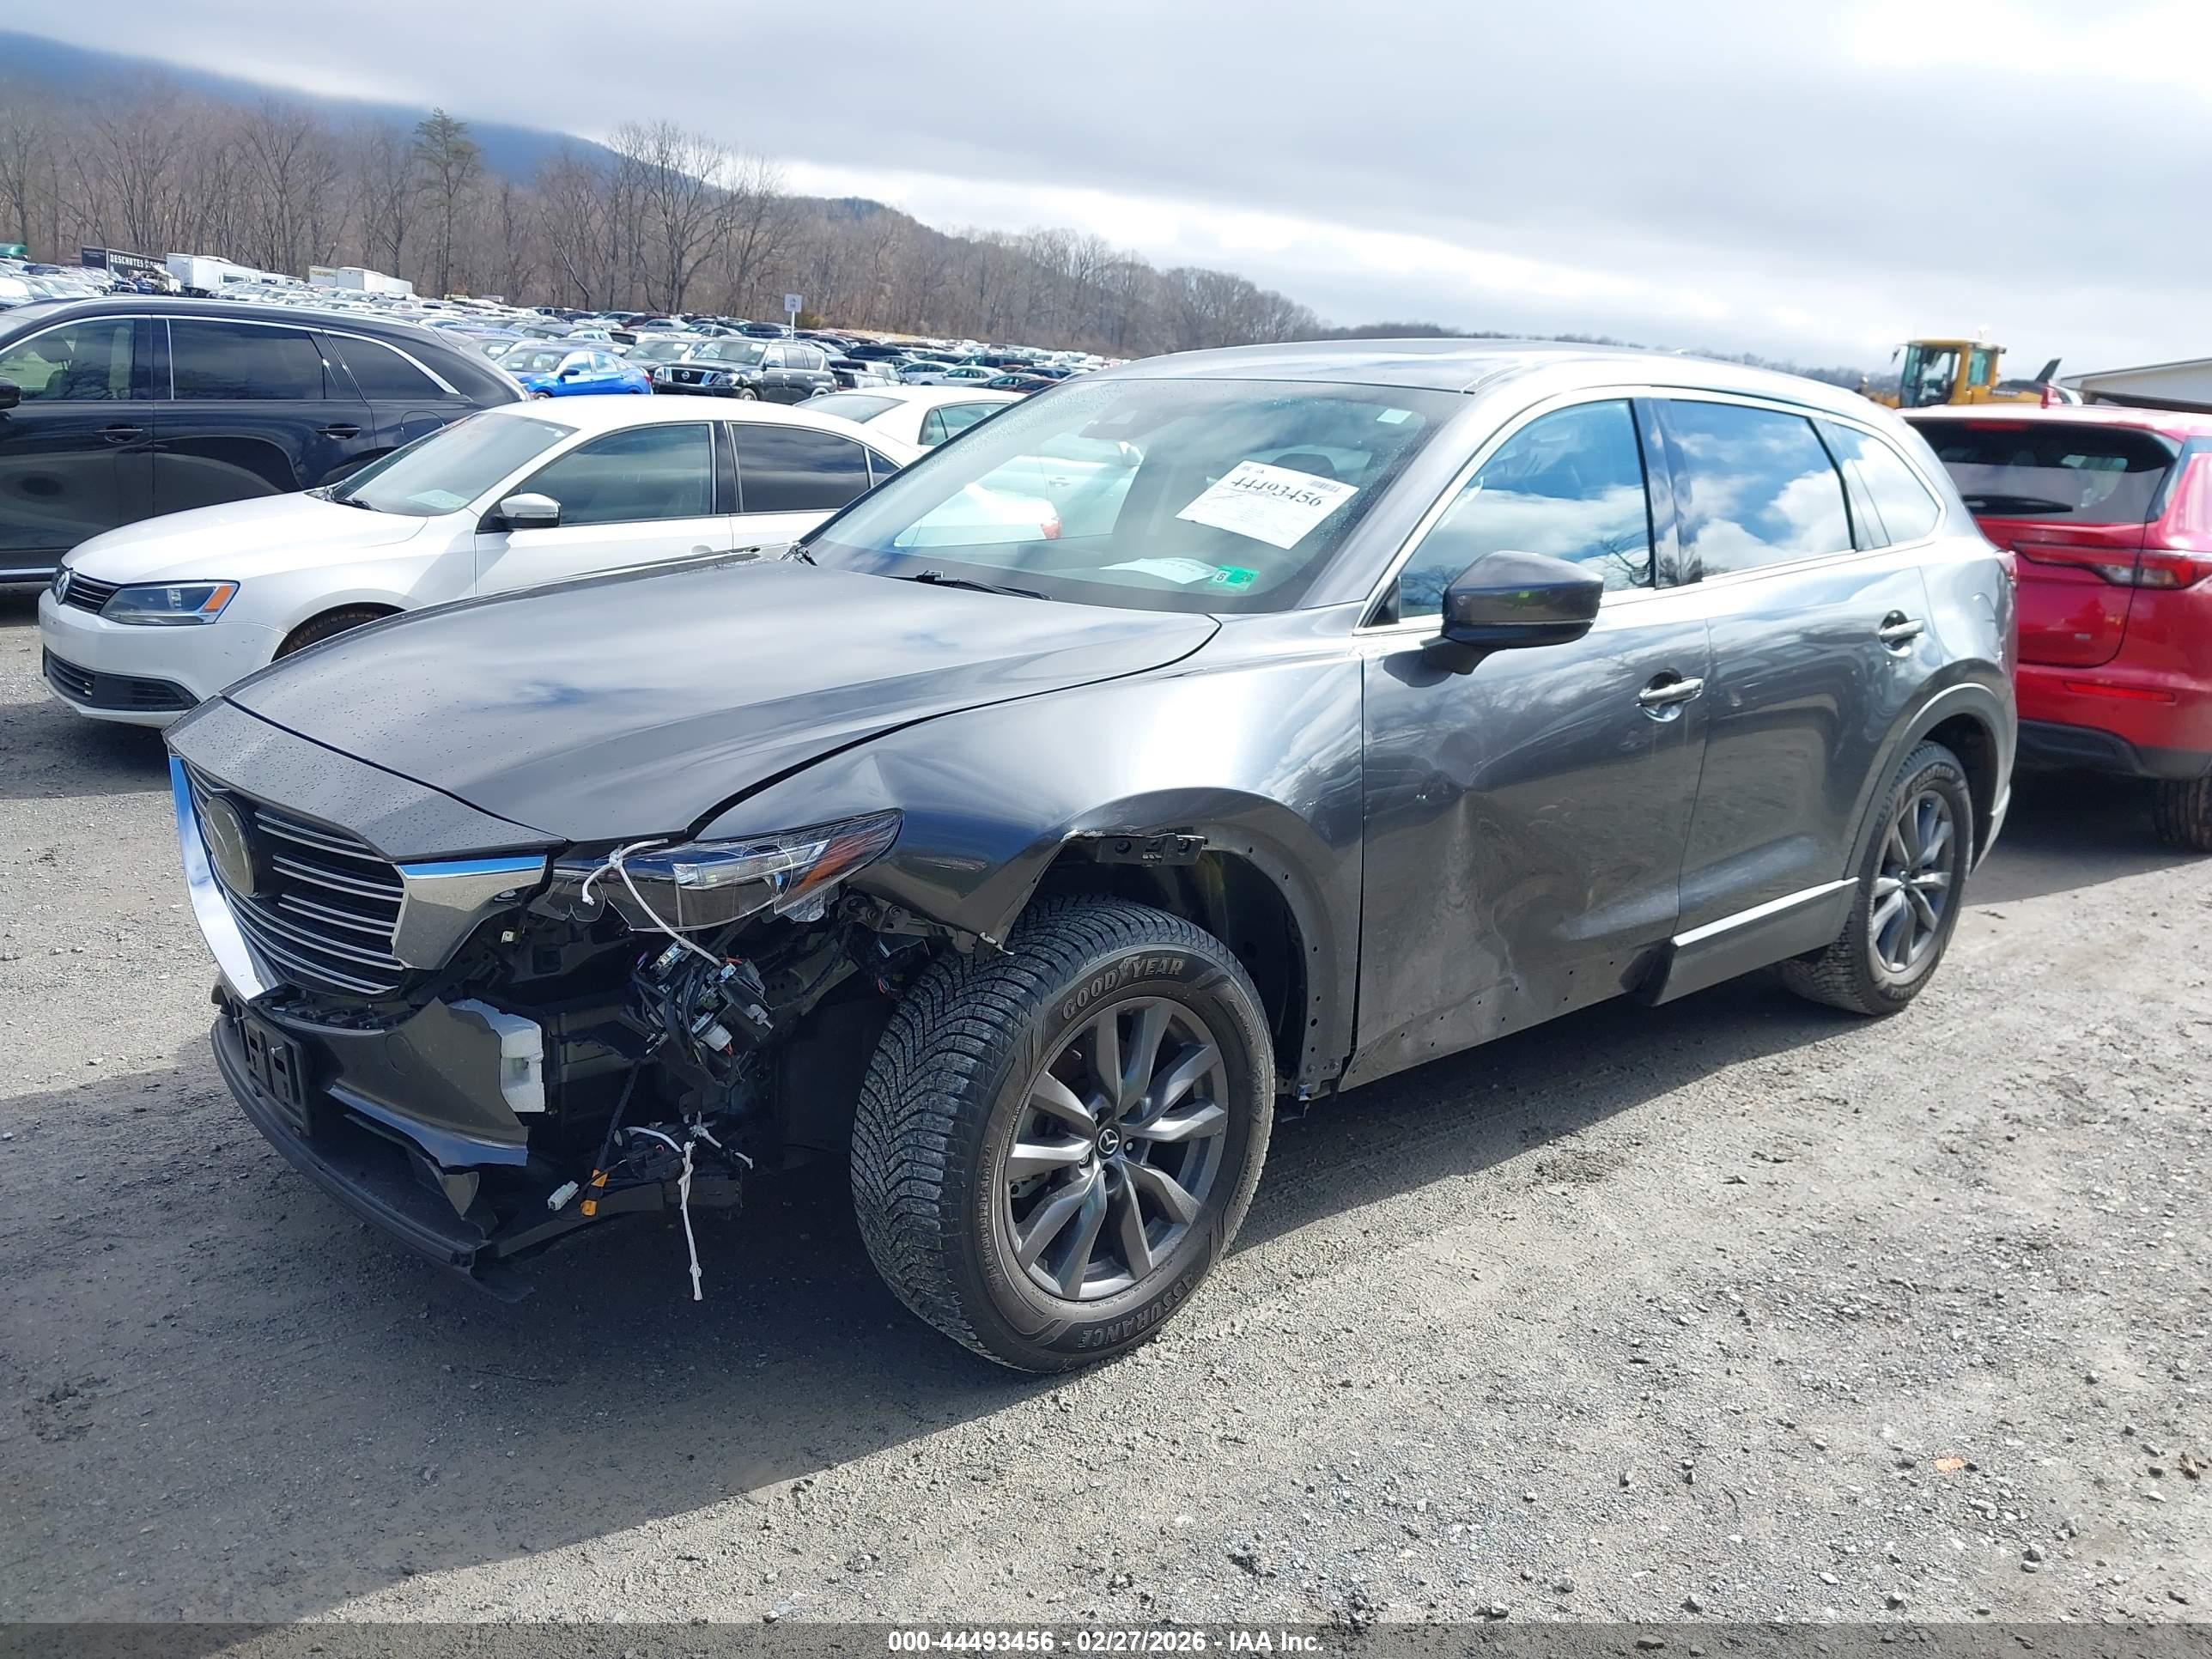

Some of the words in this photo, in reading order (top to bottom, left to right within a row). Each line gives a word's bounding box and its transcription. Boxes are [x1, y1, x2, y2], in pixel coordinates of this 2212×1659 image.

[109, 253, 143, 268] DESCHUTES
[1231, 476, 1323, 507] 44493456
[1062, 955, 1185, 1020] GOODYEAR
[1077, 1271, 1197, 1348] ASSURANCE
